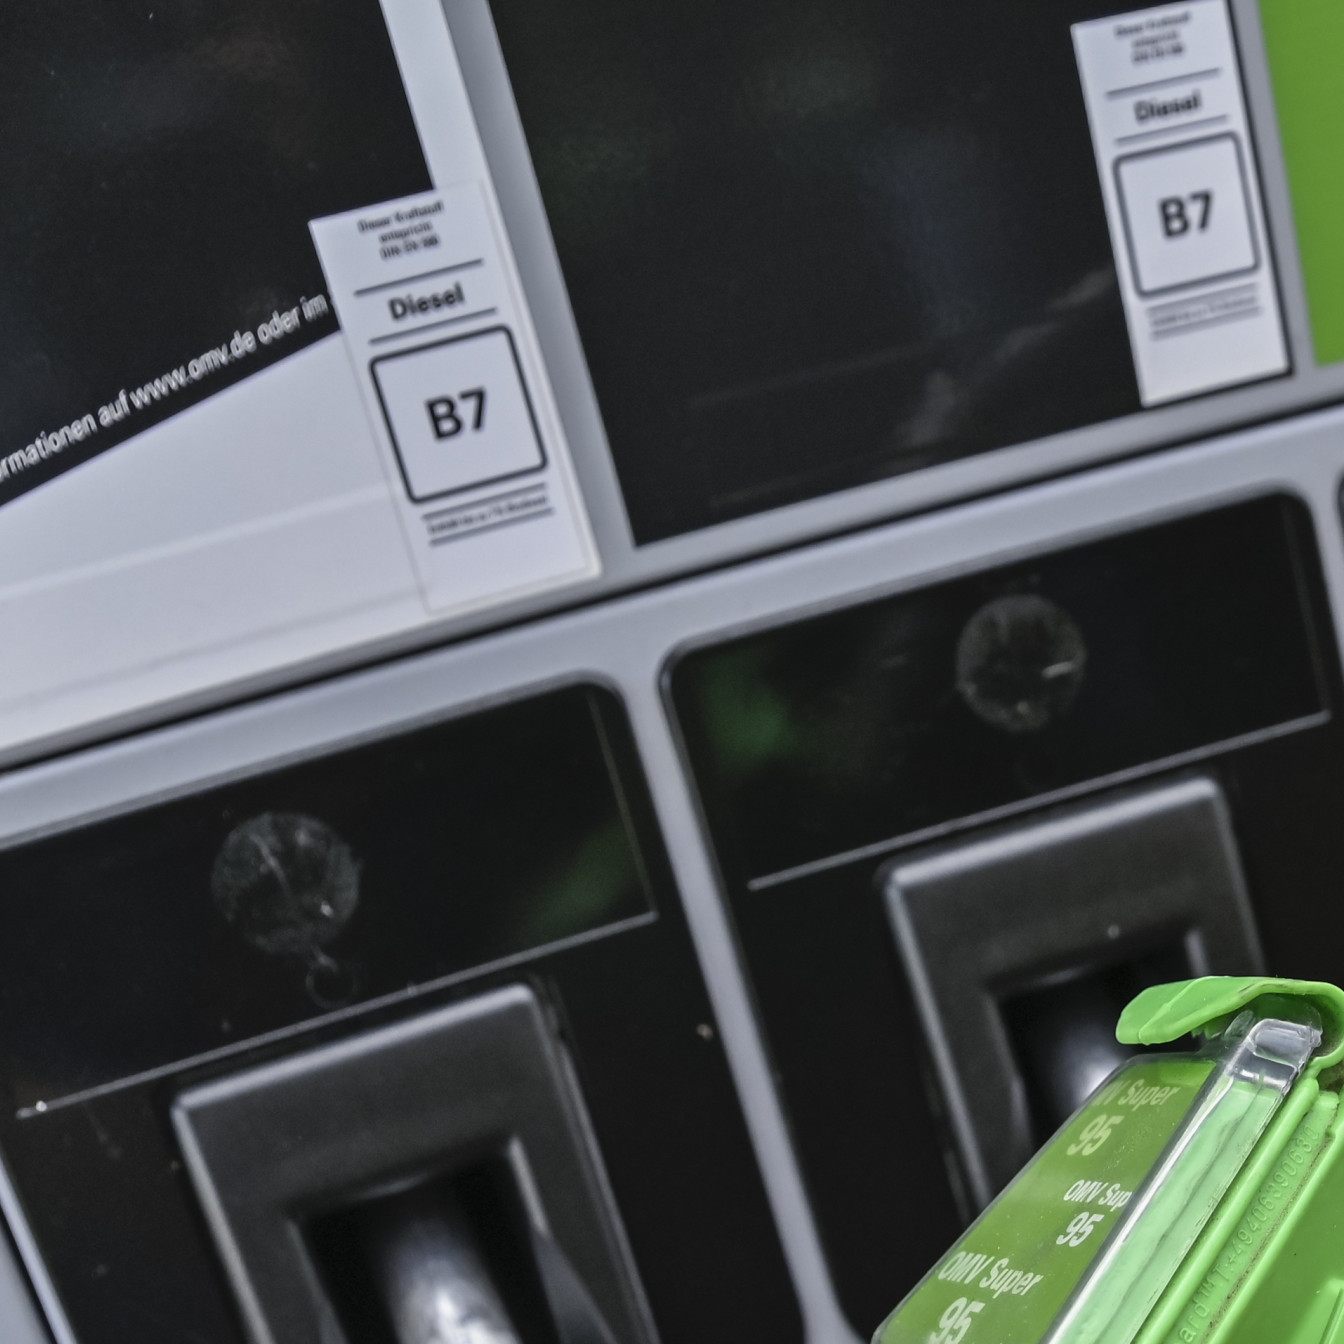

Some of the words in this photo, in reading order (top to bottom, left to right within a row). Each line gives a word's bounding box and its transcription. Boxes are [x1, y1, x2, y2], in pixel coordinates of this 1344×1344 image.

[1133, 89, 1203, 124] Diesel
[1158, 190, 1214, 240] B7
[388, 281, 465, 320] Diesel
[0, 414, 97, 482] rmationen
[98, 389, 131, 427] auf
[129, 330, 257, 410] www.omv.de
[257, 307, 300, 345] oder
[300, 294, 329, 321] im
[423, 387, 489, 442] B7
[1118, 1079, 1181, 1111] Super
[1067, 1114, 1125, 1156] 95
[1063, 1180, 1105, 1202] OMV
[1098, 1183, 1132, 1212] Sup
[1056, 1211, 1105, 1247] 95
[938, 1251, 995, 1284] OMV
[979, 1258, 1043, 1299] Super
